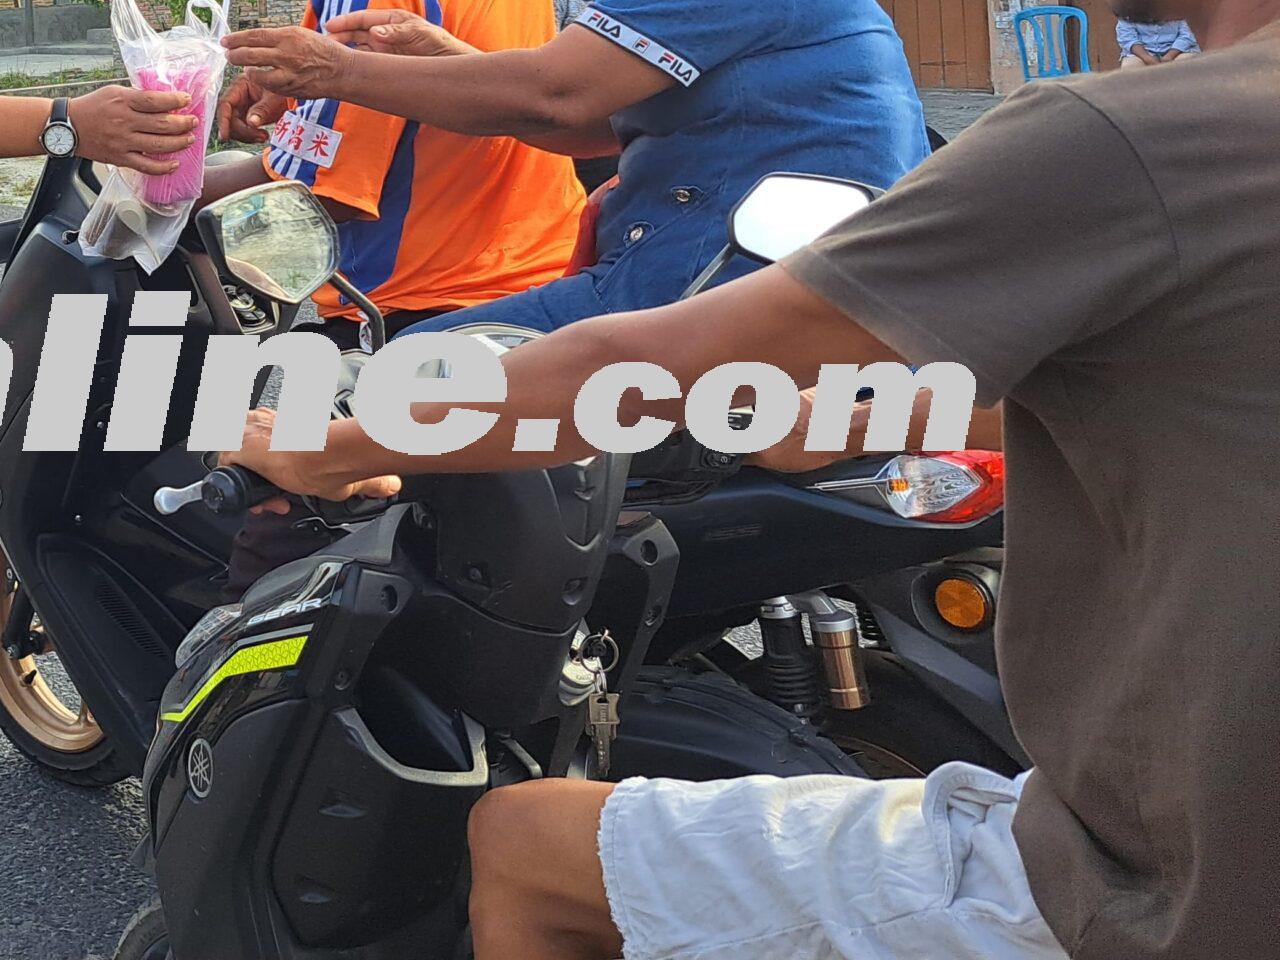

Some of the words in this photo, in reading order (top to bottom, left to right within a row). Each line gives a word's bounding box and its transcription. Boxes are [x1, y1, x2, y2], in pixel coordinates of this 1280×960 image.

[587, 11, 621, 39] FILA
[658, 51, 693, 82] FILA
[247, 597, 322, 627] GEAR
